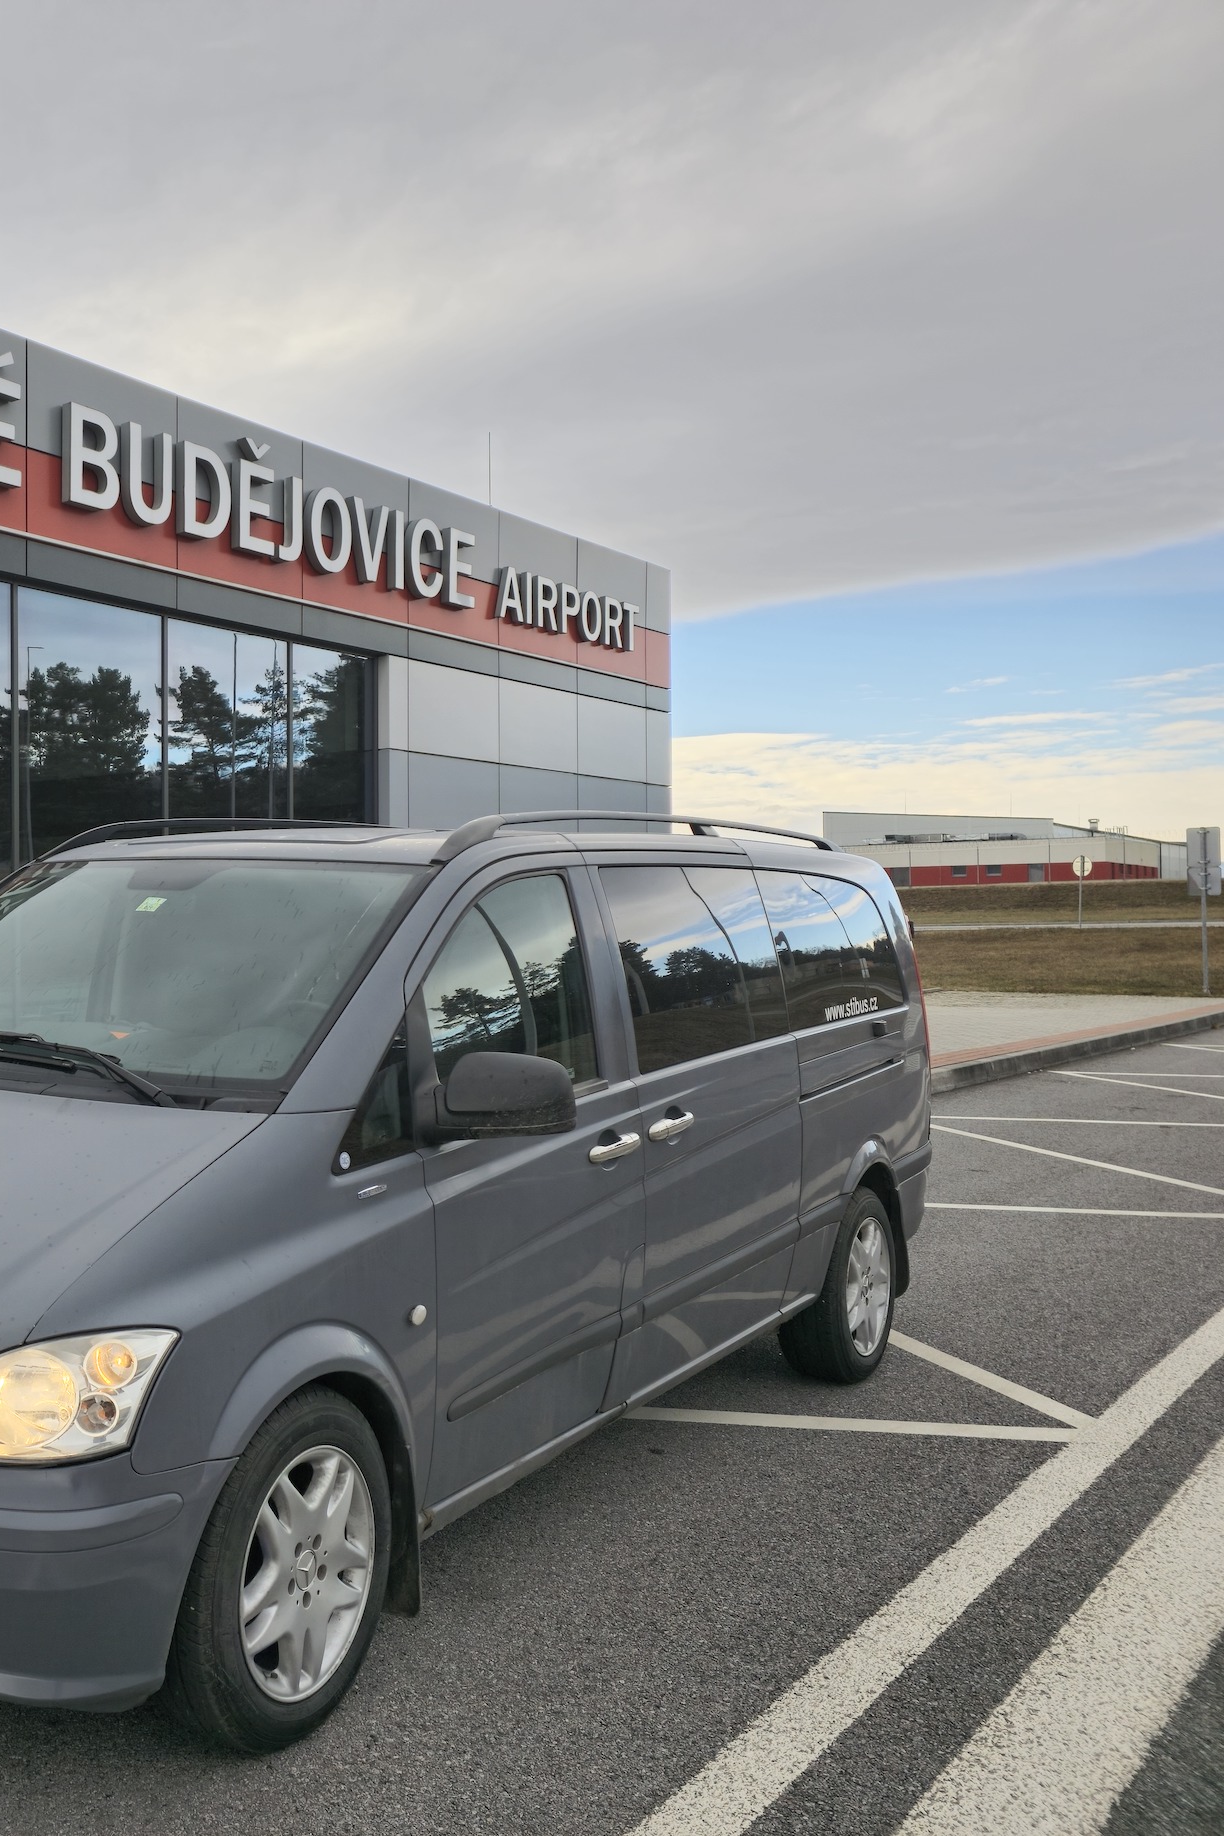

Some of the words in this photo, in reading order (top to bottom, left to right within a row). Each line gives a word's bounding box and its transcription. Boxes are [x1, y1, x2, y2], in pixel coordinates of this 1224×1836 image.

[61, 401, 476, 610] BUDĚJOVICE
[495, 566, 640, 651] AIRPORT
[824, 996, 879, 1021] www.stibus.cz
